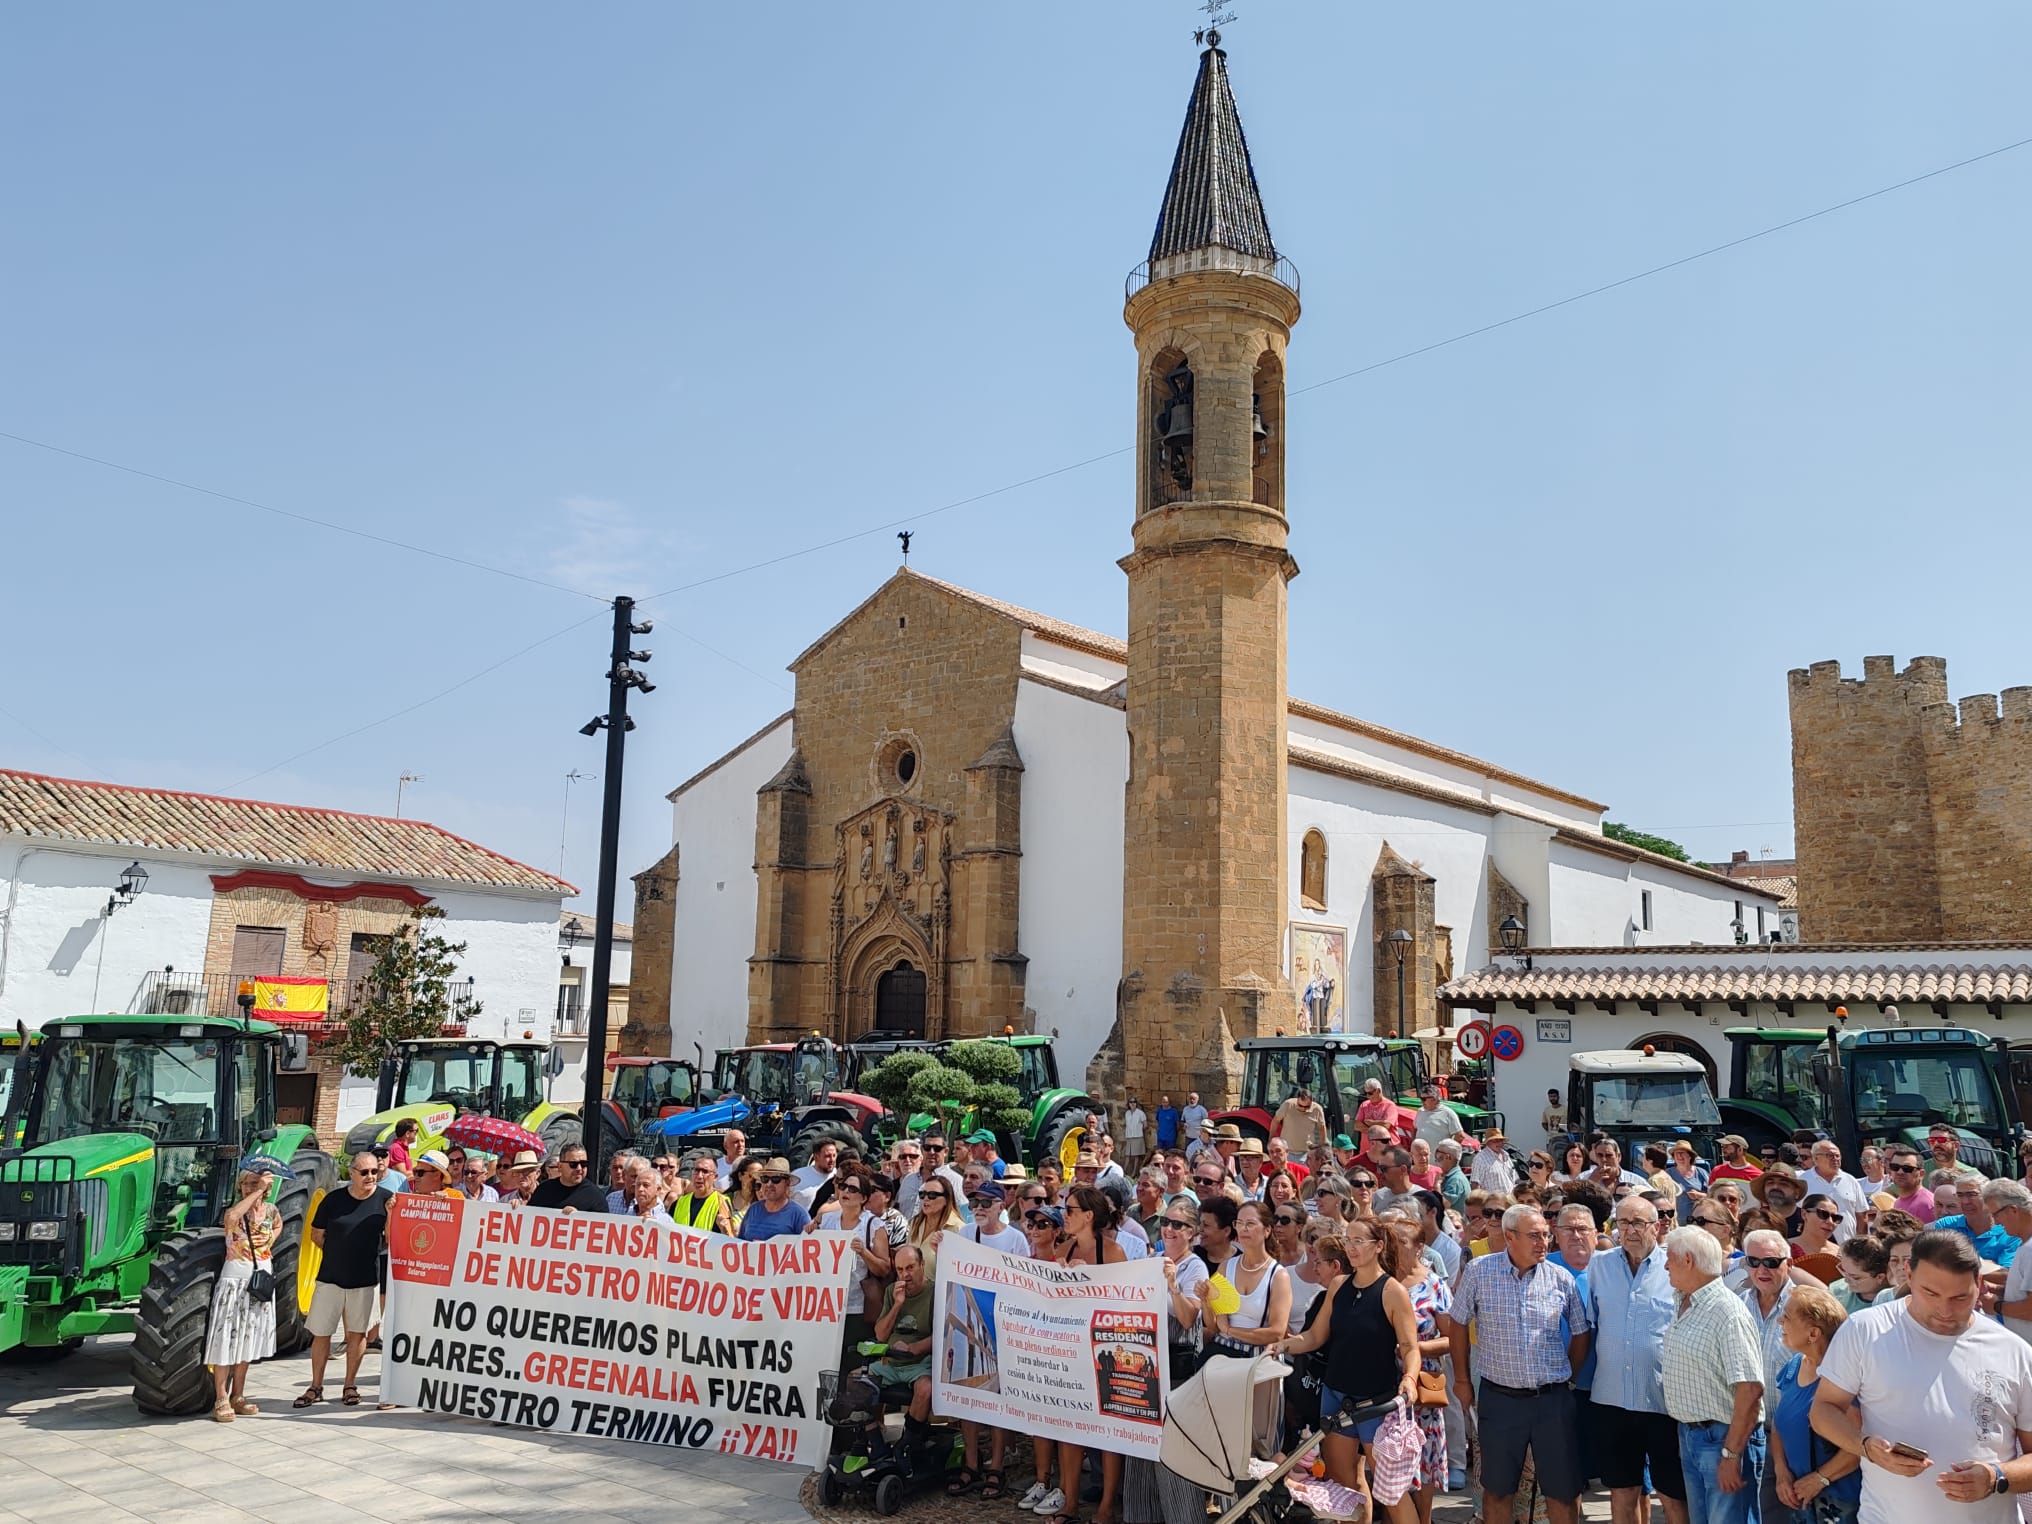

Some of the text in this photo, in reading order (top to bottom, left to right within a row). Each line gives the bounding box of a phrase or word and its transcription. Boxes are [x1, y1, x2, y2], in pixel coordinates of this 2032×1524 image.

[428, 1112, 450, 1124] CLAAS
[400, 1208, 455, 1223] CAMPIÑA NORTE
[407, 1198, 451, 1211] PLATAFORMA
[476, 1210, 847, 1276] ¡EN DEFENSA DEL OLIVAR Y
[1001, 1254, 1092, 1282] PLATAFORMA
[463, 1251, 502, 1286] DE
[506, 1256, 641, 1302] NUESTRO
[646, 1271, 728, 1317] MEDIO
[731, 1285, 765, 1321] DE
[1011, 1273, 1034, 1290] POR
[1035, 1282, 1055, 1298] LA
[998, 1301, 1030, 1320] Exigimos
[1031, 1310, 1040, 1320] al
[1095, 1313, 1153, 1329] LOPERA
[433, 1298, 793, 1373] NO QUEREMOS PLANTAS
[1002, 1319, 1081, 1341] Aprobar la convocatoria
[1094, 1332, 1153, 1346] RESIDENCIA
[1006, 1335, 1015, 1345] de
[1024, 1339, 1041, 1351] pleno
[1043, 1344, 1077, 1357] ordinario
[1016, 1355, 1069, 1372] para abordar la
[1027, 1371, 1034, 1382] de
[1036, 1373, 1042, 1384] la
[1043, 1375, 1085, 1391] Residencia.
[707, 1377, 807, 1419] FUERA
[1043, 1394, 1094, 1412] EXCUSAS!
[417, 1377, 798, 1461] NUESTRO TERMINO ¡¡YA!!
[960, 1396, 969, 1405] un
[970, 1398, 998, 1412] presente
[1005, 1403, 1025, 1417] futuro
[1027, 1411, 1043, 1422] para
[1044, 1416, 1074, 1429] nuestros
[1075, 1422, 1106, 1434] mayores
